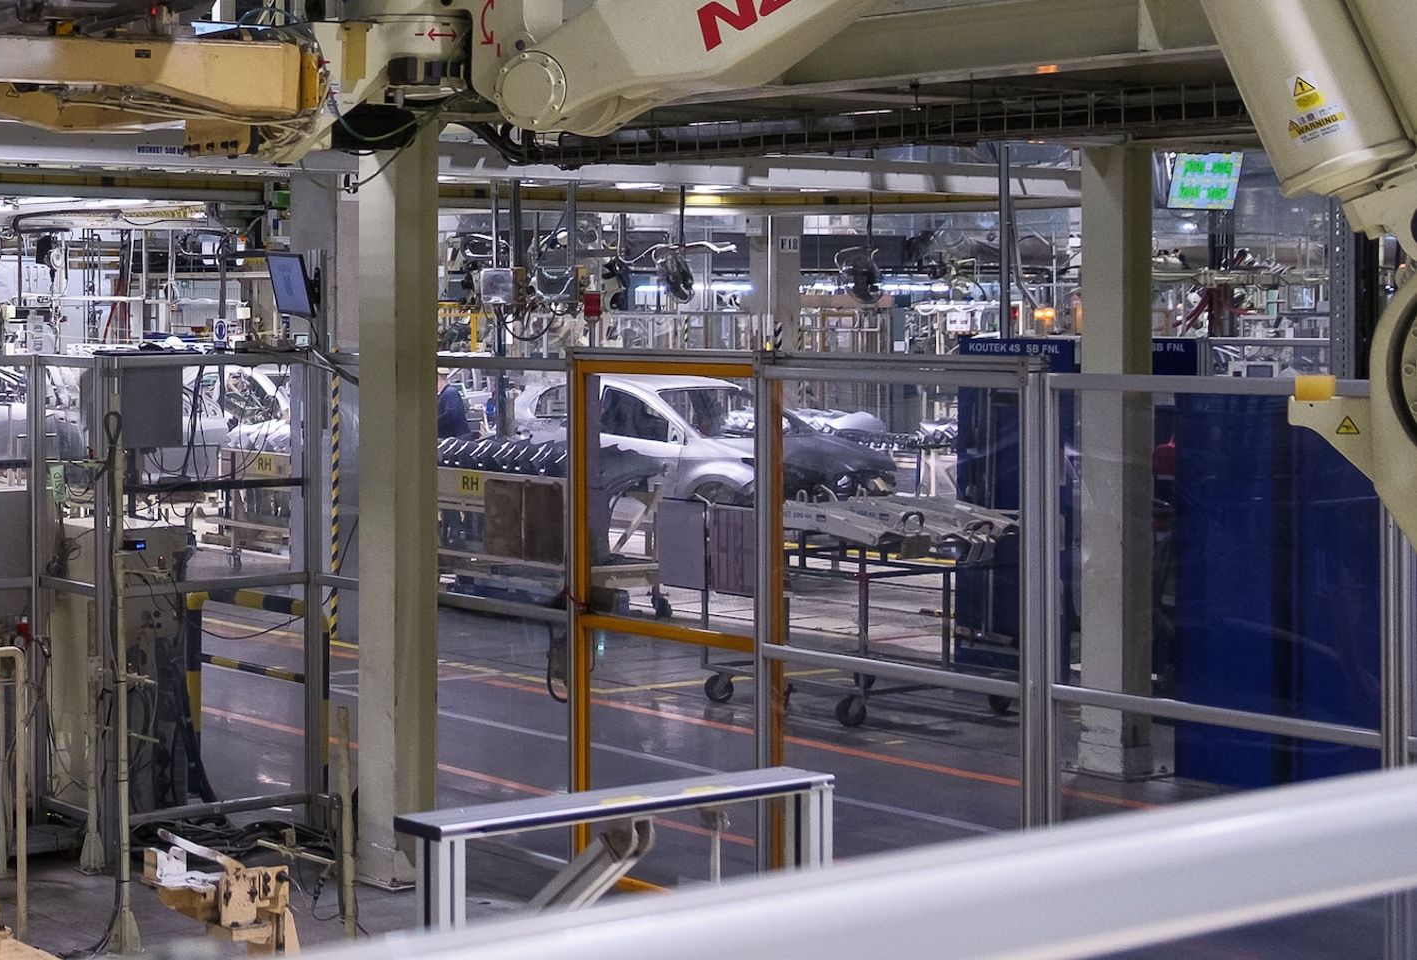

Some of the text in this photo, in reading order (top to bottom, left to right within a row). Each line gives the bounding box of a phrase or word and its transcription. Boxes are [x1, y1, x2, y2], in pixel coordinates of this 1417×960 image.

[1295, 114, 1338, 136] WARNING
[968, 342, 1060, 354] KOUTEK 4S SB FNL
[1152, 342, 1185, 353] SB FNL
[257, 457, 272, 471] RH
[462, 475, 479, 491] RH
